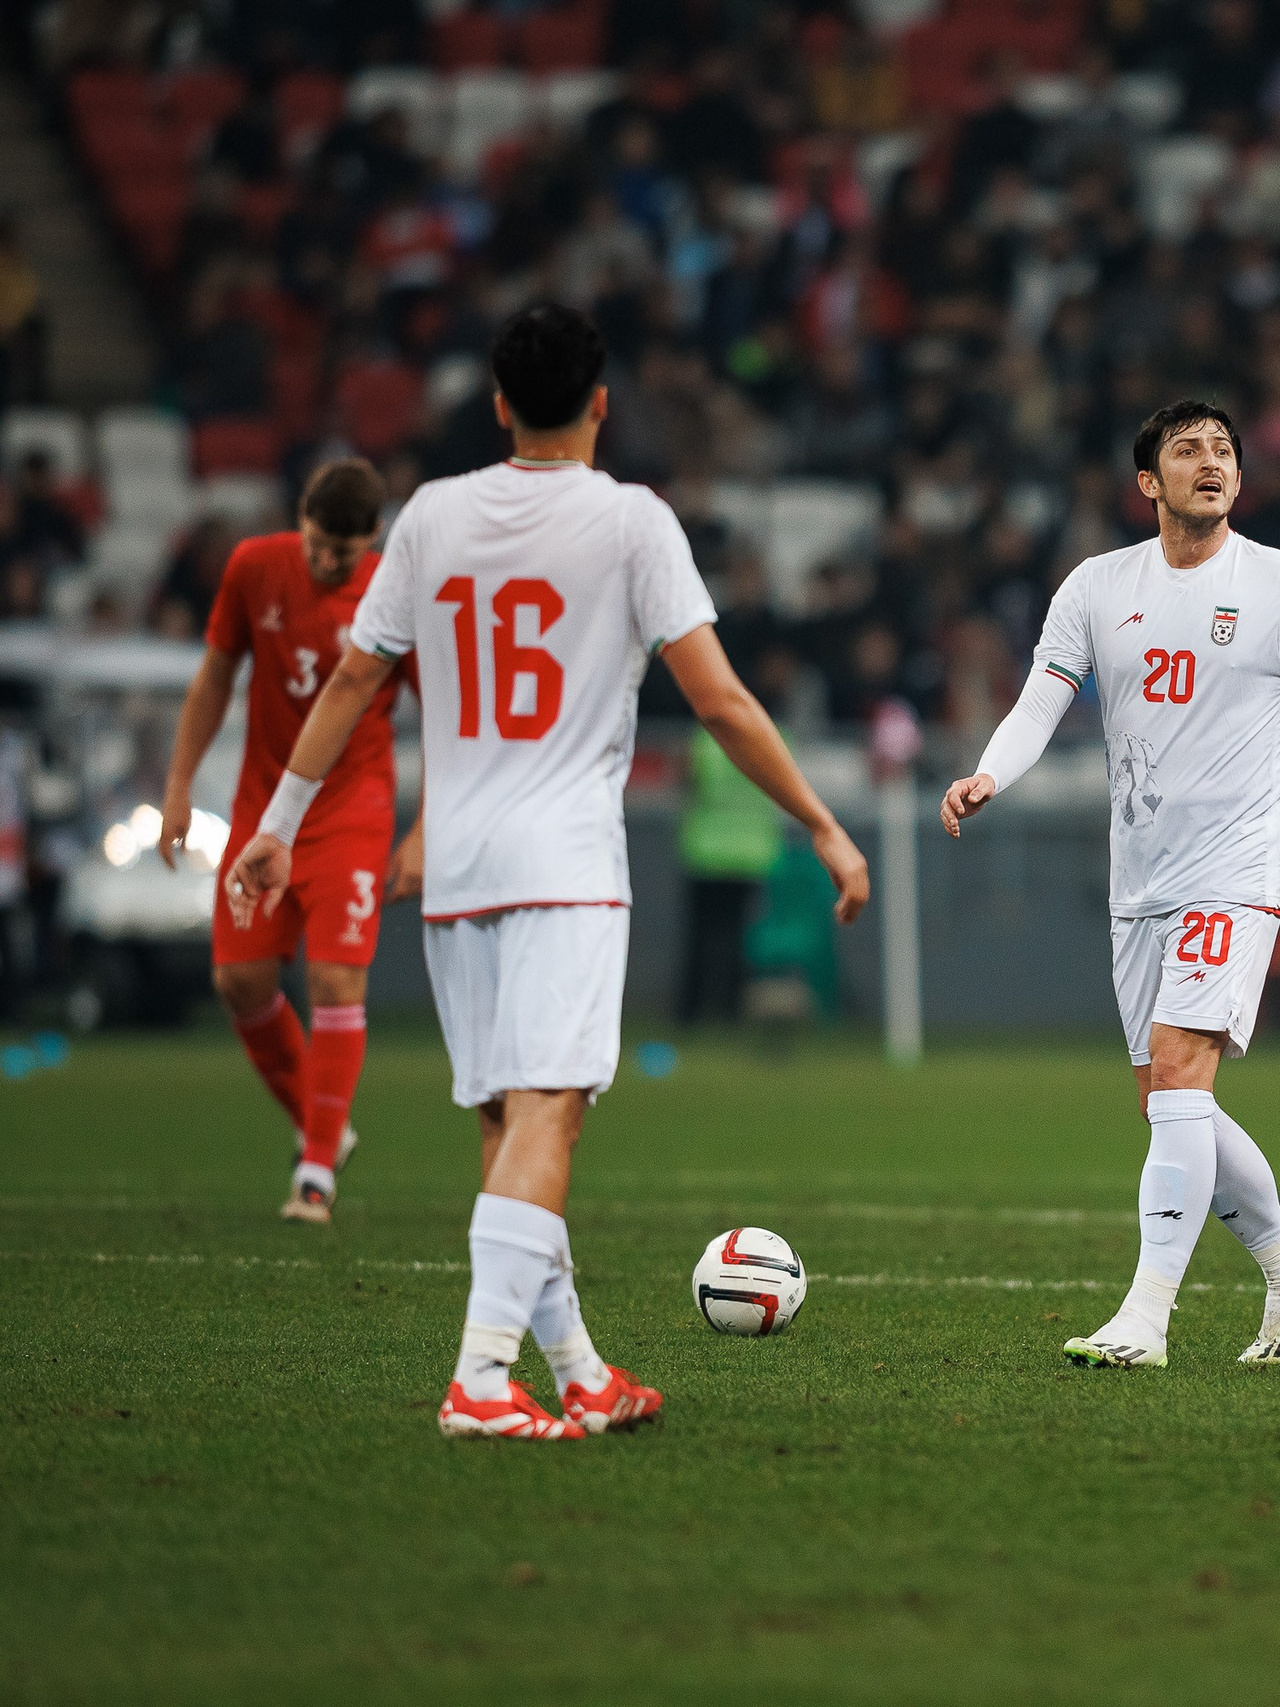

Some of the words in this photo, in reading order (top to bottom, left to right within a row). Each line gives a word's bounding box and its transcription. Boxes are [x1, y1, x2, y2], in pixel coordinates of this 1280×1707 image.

[285, 647, 319, 699] 3
[434, 576, 565, 740] 16
[1143, 648, 1196, 704] 20
[346, 869, 376, 920] 3
[1176, 911, 1233, 966] 20
